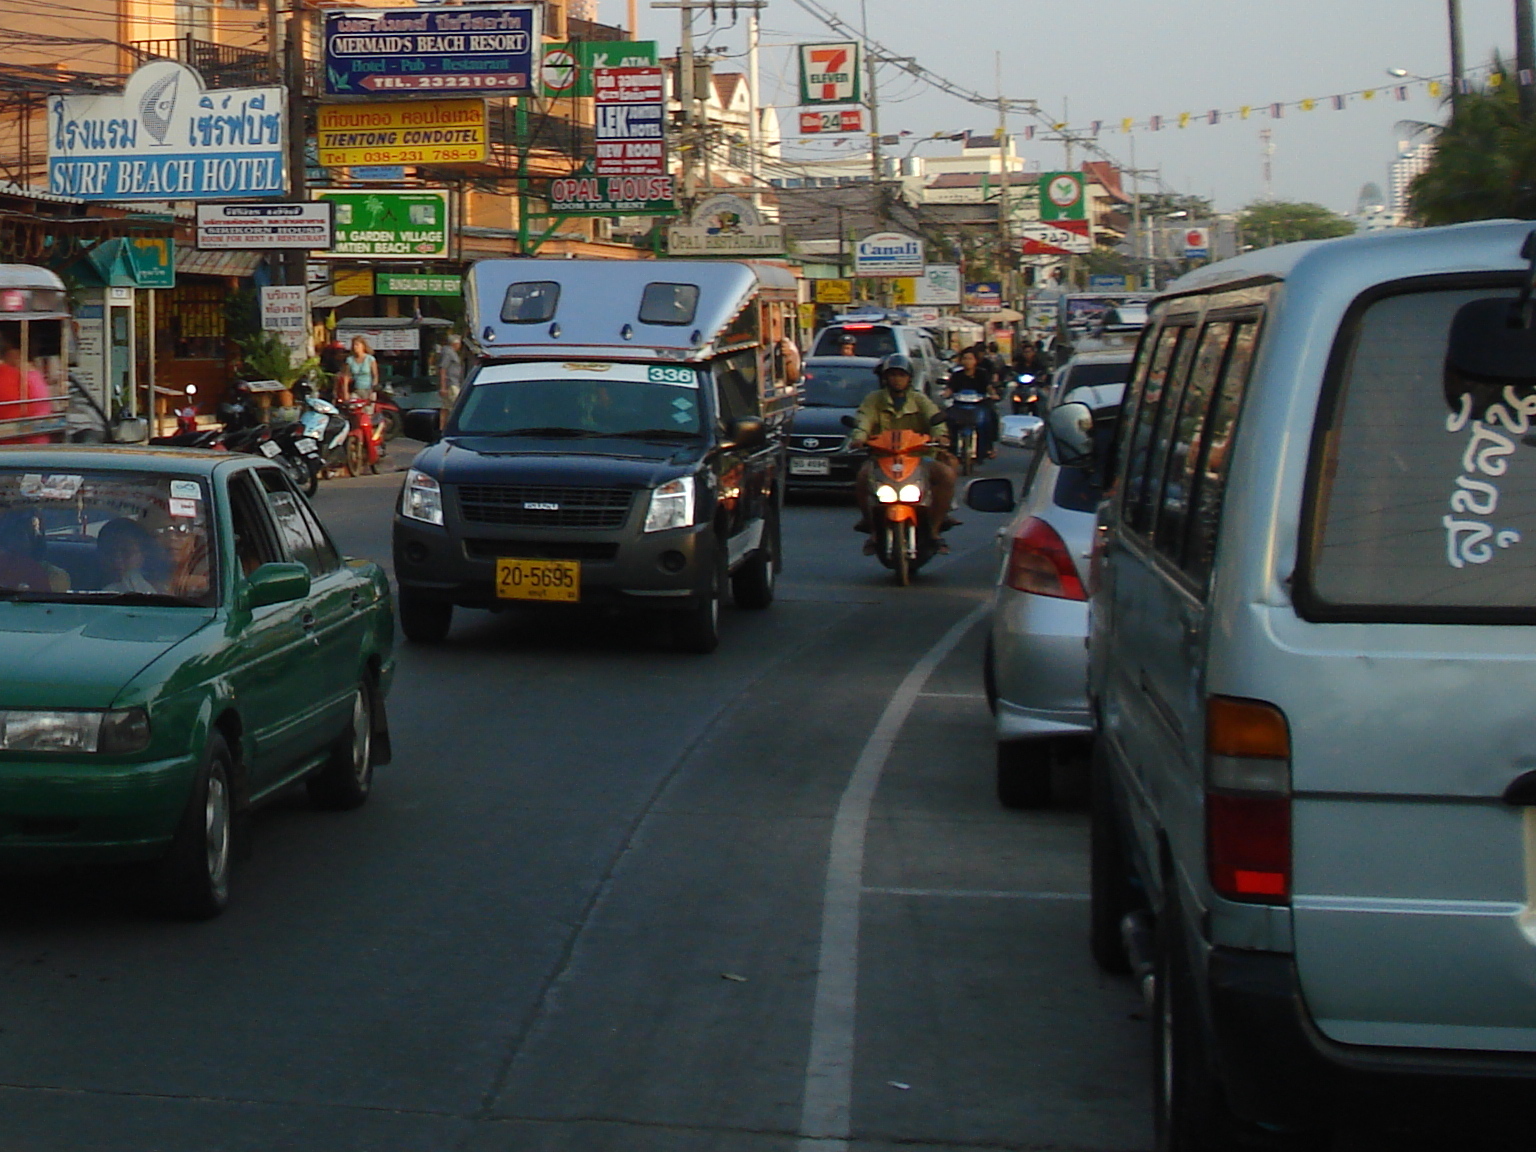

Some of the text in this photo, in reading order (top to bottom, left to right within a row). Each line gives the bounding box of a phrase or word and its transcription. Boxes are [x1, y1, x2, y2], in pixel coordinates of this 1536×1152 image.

[335, 34, 525, 54] MERMAID'S BEACH RESORT
[352, 58, 386, 72] Hotel
[401, 58, 426, 72] Pub
[442, 57, 510, 70] Restaurant
[373, 76, 519, 88] TEL. 232210-6
[53, 100, 137, 150] โรงแรม
[596, 106, 629, 138] LEK
[822, 114, 840, 129] 24
[325, 130, 479, 146] TIENTONG CONDOTEL
[52, 157, 281, 196] SURF BEACH HOTEL
[552, 176, 673, 202] OPAL HOUSE
[350, 231, 395, 242] GARDEN
[400, 231, 443, 242] VILLAGE
[335, 243, 371, 253] MTIEN
[375, 243, 411, 253] BEACH
[859, 242, 918, 256] Canali
[650, 367, 693, 383] 336
[501, 566, 574, 588] 20-5695
